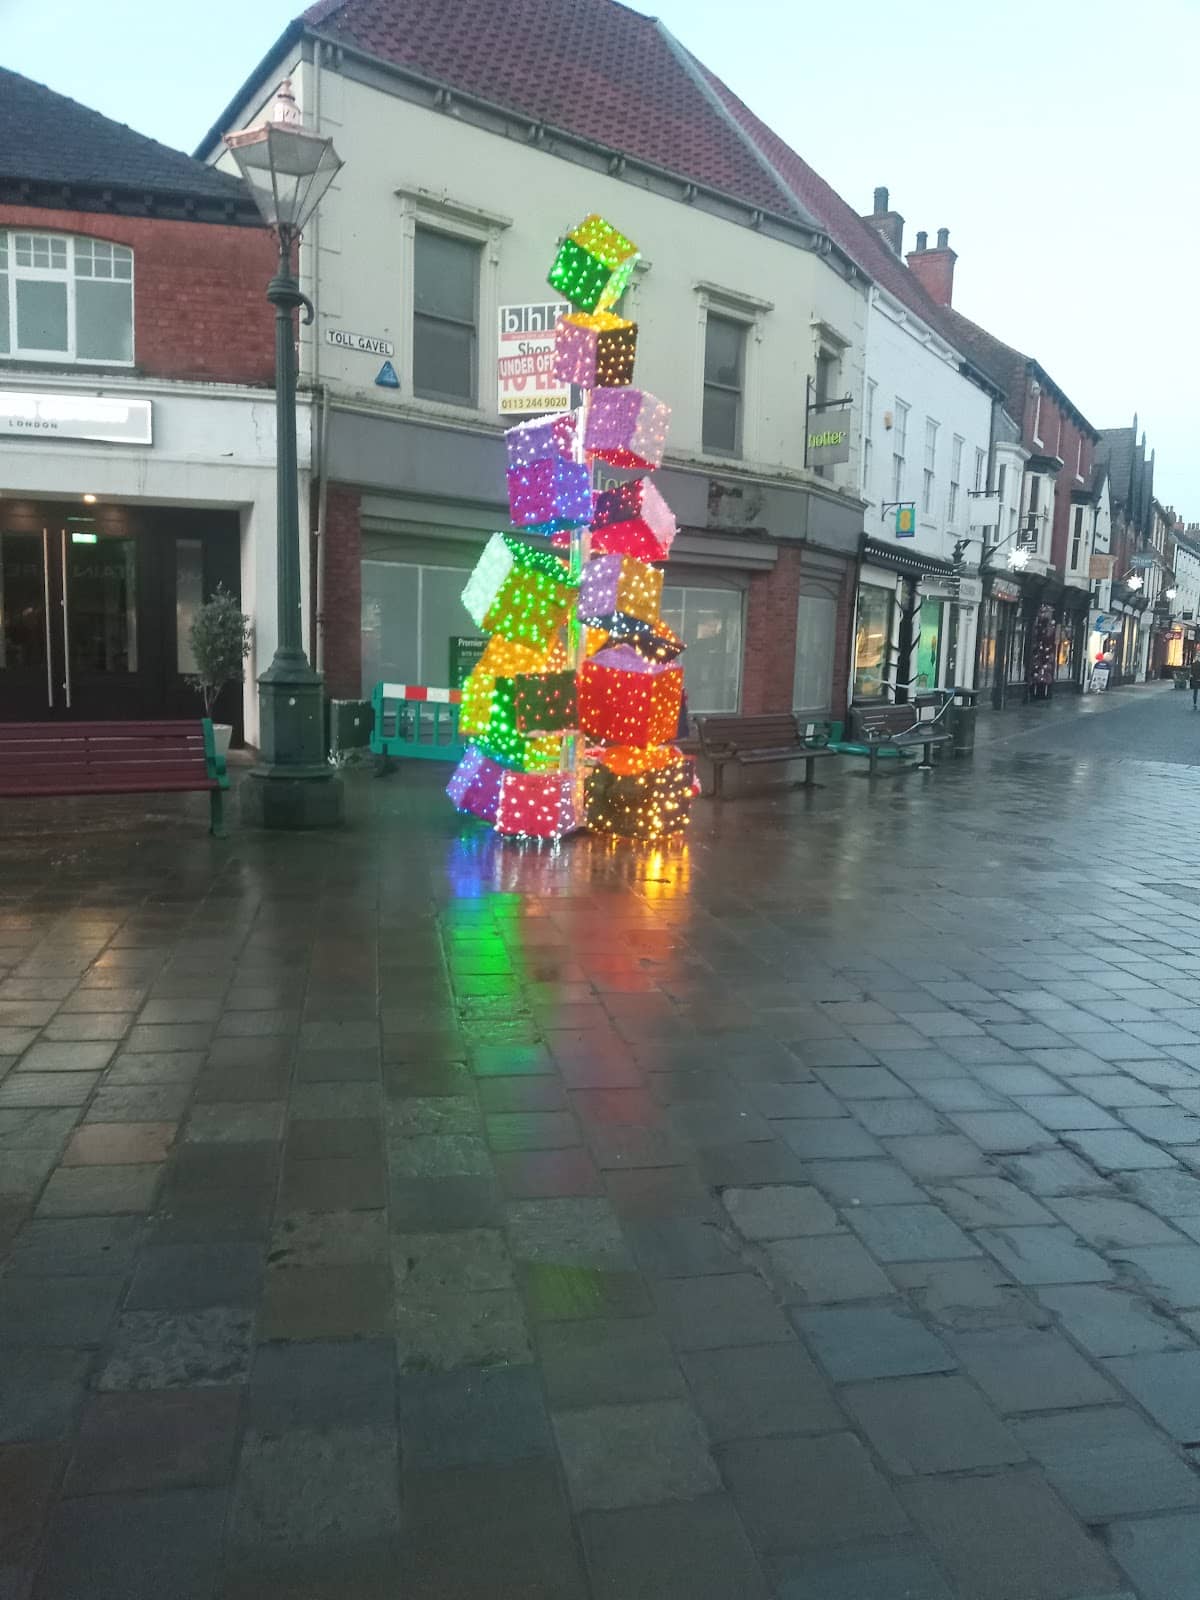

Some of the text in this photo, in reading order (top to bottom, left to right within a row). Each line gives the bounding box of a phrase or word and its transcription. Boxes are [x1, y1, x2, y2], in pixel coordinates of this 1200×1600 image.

[328, 331, 391, 354] TOLL GAVEL
[518, 342, 551, 356] Shop
[500, 356, 534, 376] UNDER
[501, 396, 567, 409] 0113 244 9020
[8, 419, 58, 429] LONDON
